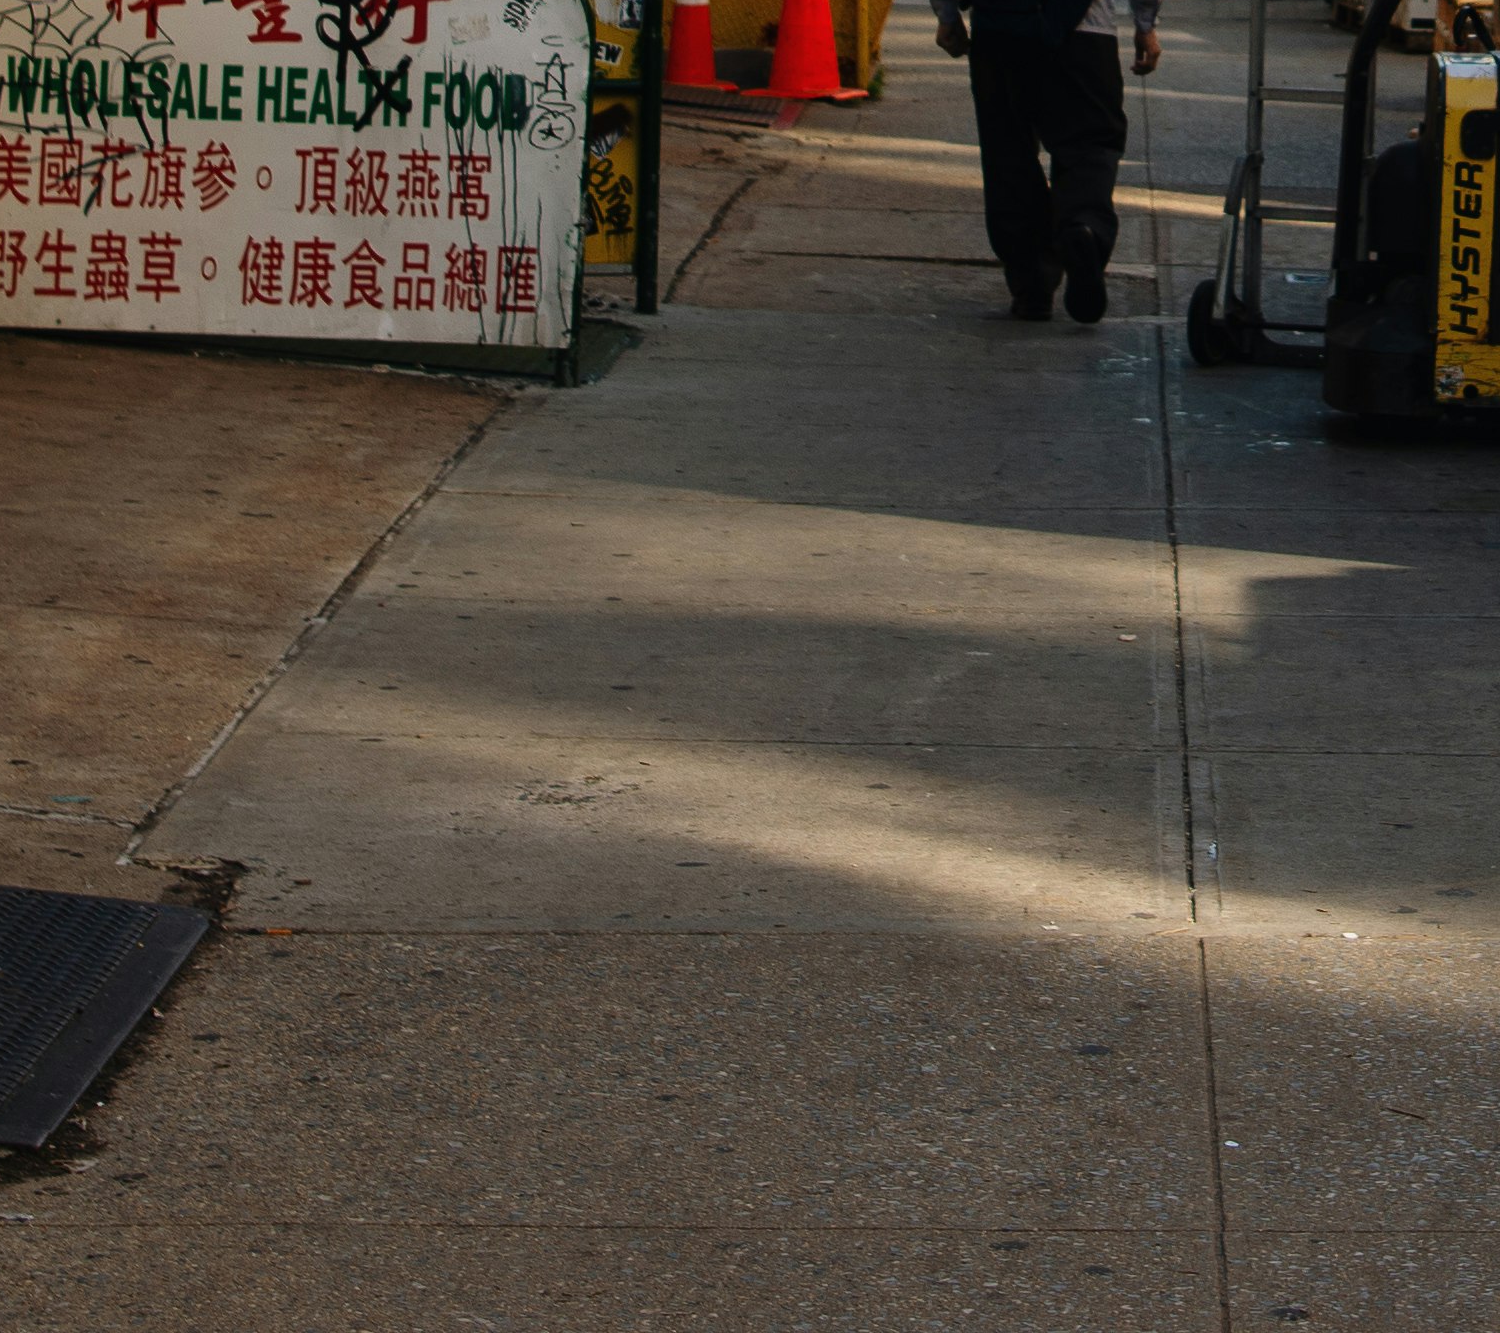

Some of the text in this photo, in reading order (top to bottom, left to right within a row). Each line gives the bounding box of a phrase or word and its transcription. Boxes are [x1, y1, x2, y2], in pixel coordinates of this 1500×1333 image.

[6, 55, 246, 124] WHOLESALE
[256, 63, 409, 128] HEALTH
[421, 70, 528, 132] FOOD
[1449, 159, 1485, 336] HYSTER
